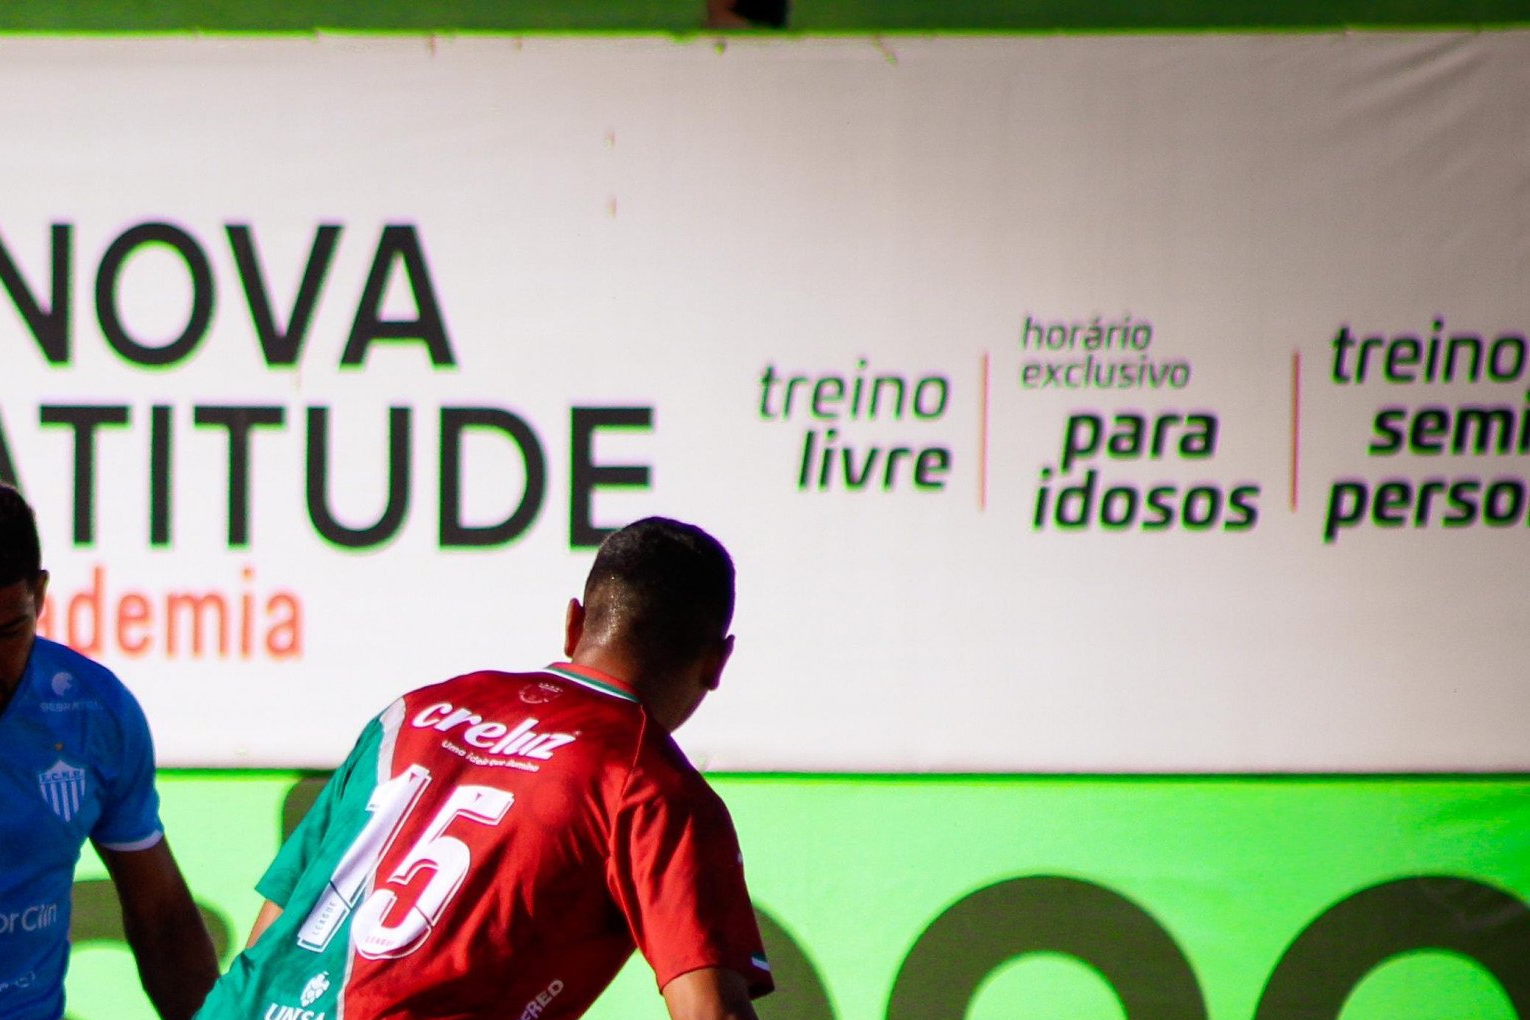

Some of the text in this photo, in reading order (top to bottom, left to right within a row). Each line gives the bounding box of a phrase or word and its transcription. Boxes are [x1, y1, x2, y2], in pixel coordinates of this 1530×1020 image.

[1021, 315, 1153, 353] horário
[1331, 319, 1528, 385] treino
[759, 358, 951, 421] treino
[1021, 354, 1191, 389] exclusivo
[797, 428, 954, 492] livre
[1060, 409, 1219, 474] para
[1032, 469, 1261, 532] idosos
[1322, 476, 1530, 545] perso
[412, 702, 577, 760] creluz
[297, 764, 515, 960] 15
